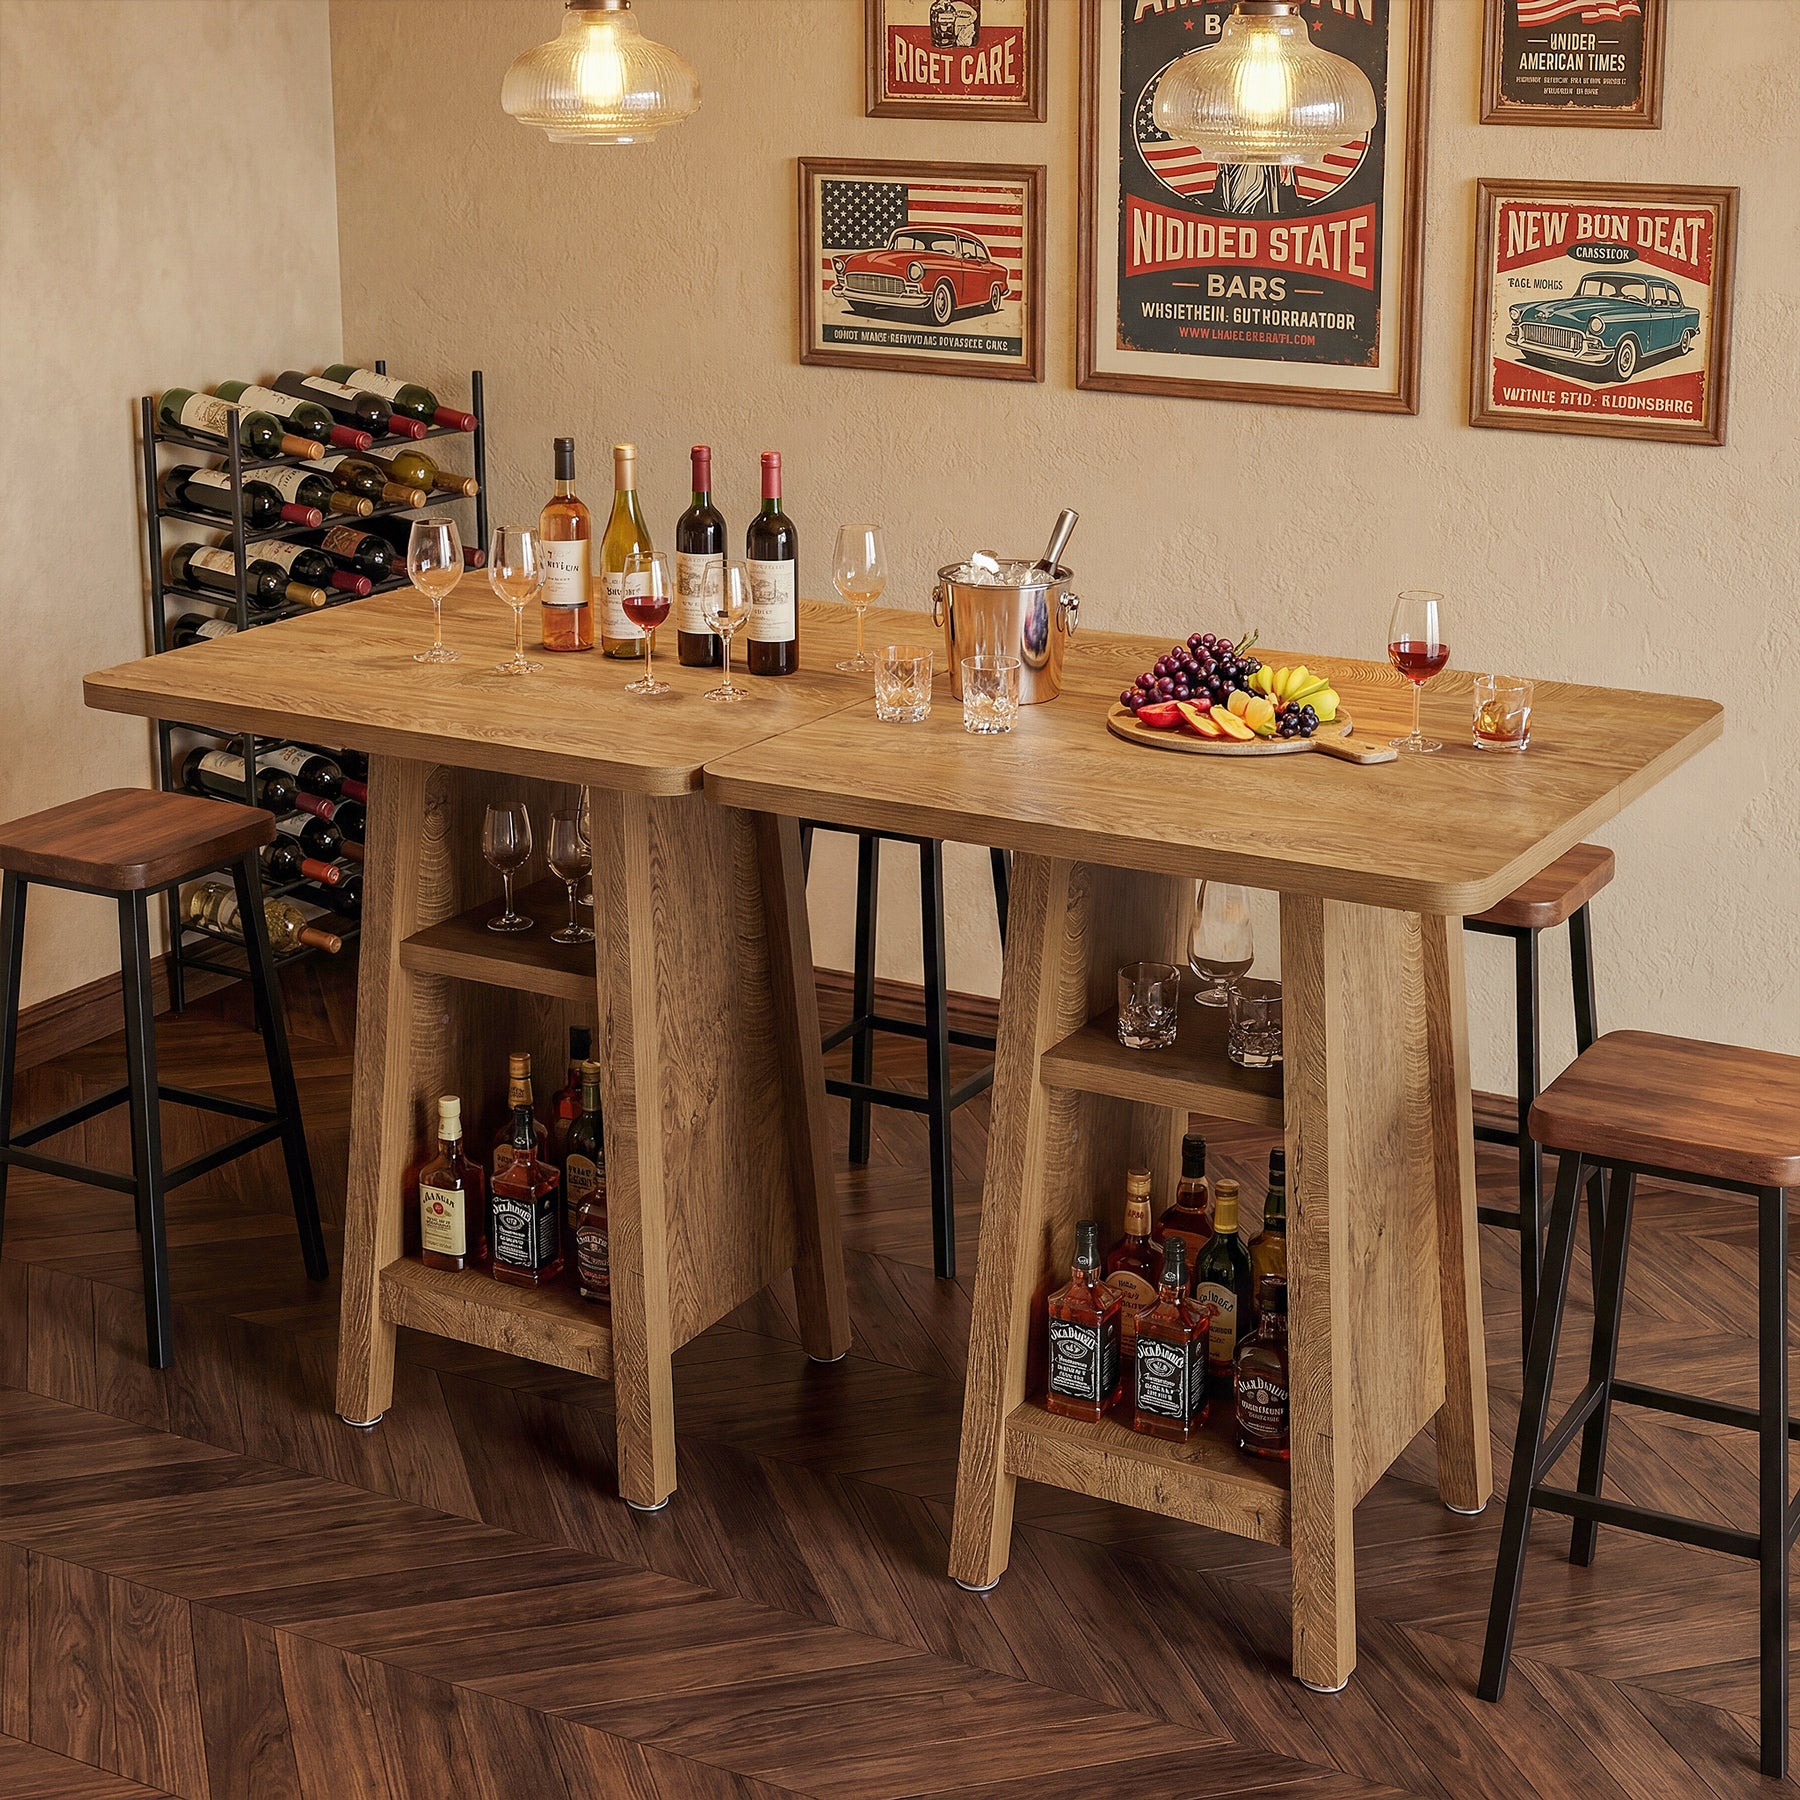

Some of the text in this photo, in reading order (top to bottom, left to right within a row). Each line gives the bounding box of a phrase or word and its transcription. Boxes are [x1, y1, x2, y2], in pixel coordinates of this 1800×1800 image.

[894, 34, 1016, 85] RIGET CARE
[1519, 52, 1626, 72] AMERICAN TIMES
[1133, 207, 1368, 279] NIDIDED STATE
[1506, 210, 1570, 259] NEW
[1636, 216, 1705, 267] DEAT
[1207, 273, 1287, 301] BARS
